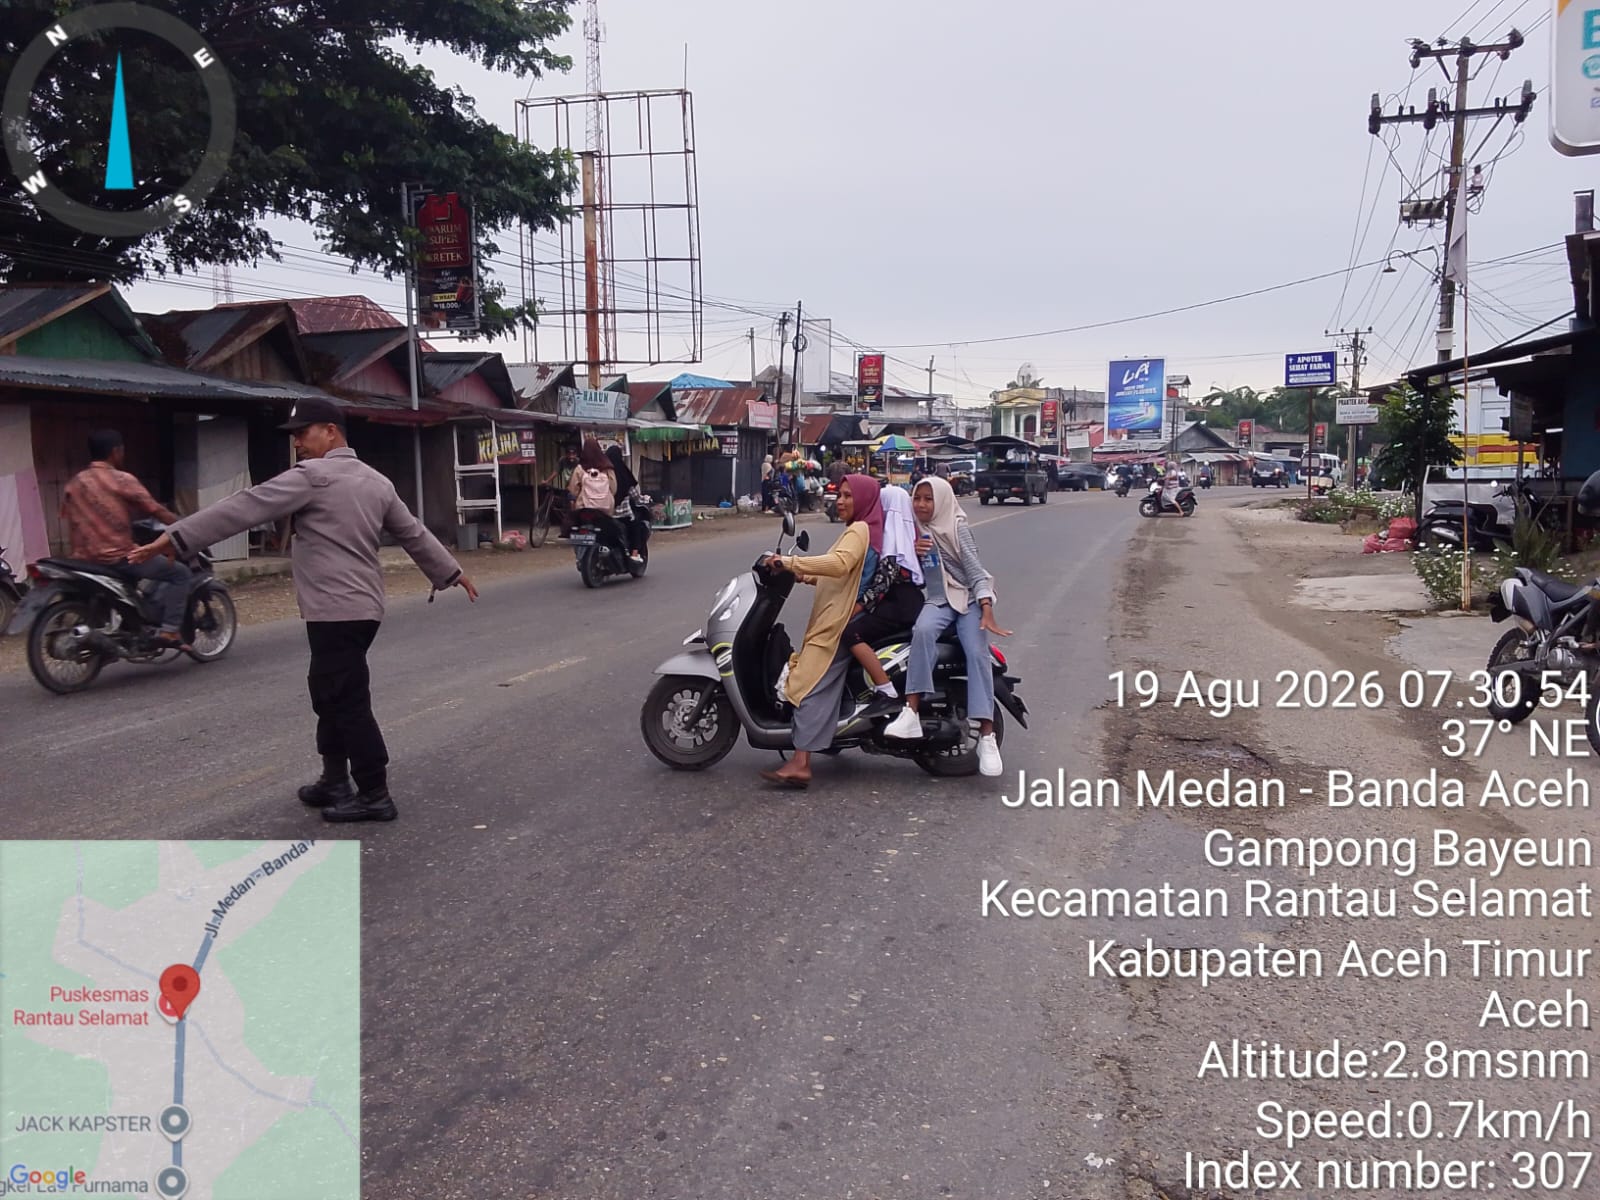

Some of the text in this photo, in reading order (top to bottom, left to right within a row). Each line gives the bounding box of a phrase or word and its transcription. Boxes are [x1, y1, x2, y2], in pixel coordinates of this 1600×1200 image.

[428, 251, 464, 263] RETEK
[1297, 354, 1323, 364] APOTEK
[1289, 362, 1332, 371] SEHAT FARMA
